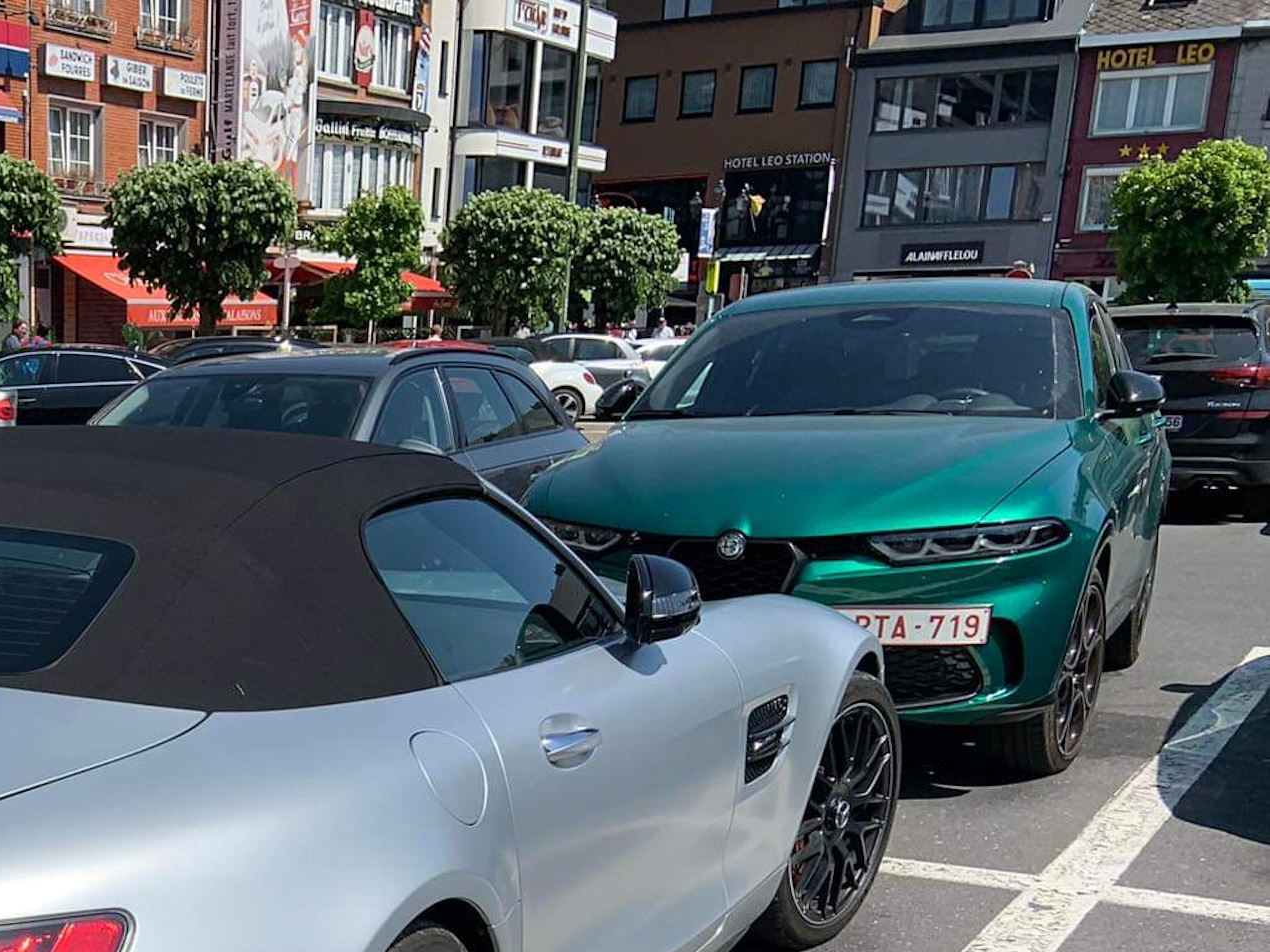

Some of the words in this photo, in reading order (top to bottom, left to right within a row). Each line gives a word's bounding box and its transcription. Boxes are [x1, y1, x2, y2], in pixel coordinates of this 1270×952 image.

[1096, 46, 1157, 71] HOTEL
[1176, 42, 1216, 65] LEO
[222, 54, 236, 113] MARTELANGE
[723, 157, 759, 170] HOTEL
[762, 155, 784, 168] LEO
[785, 152, 831, 167] STATION
